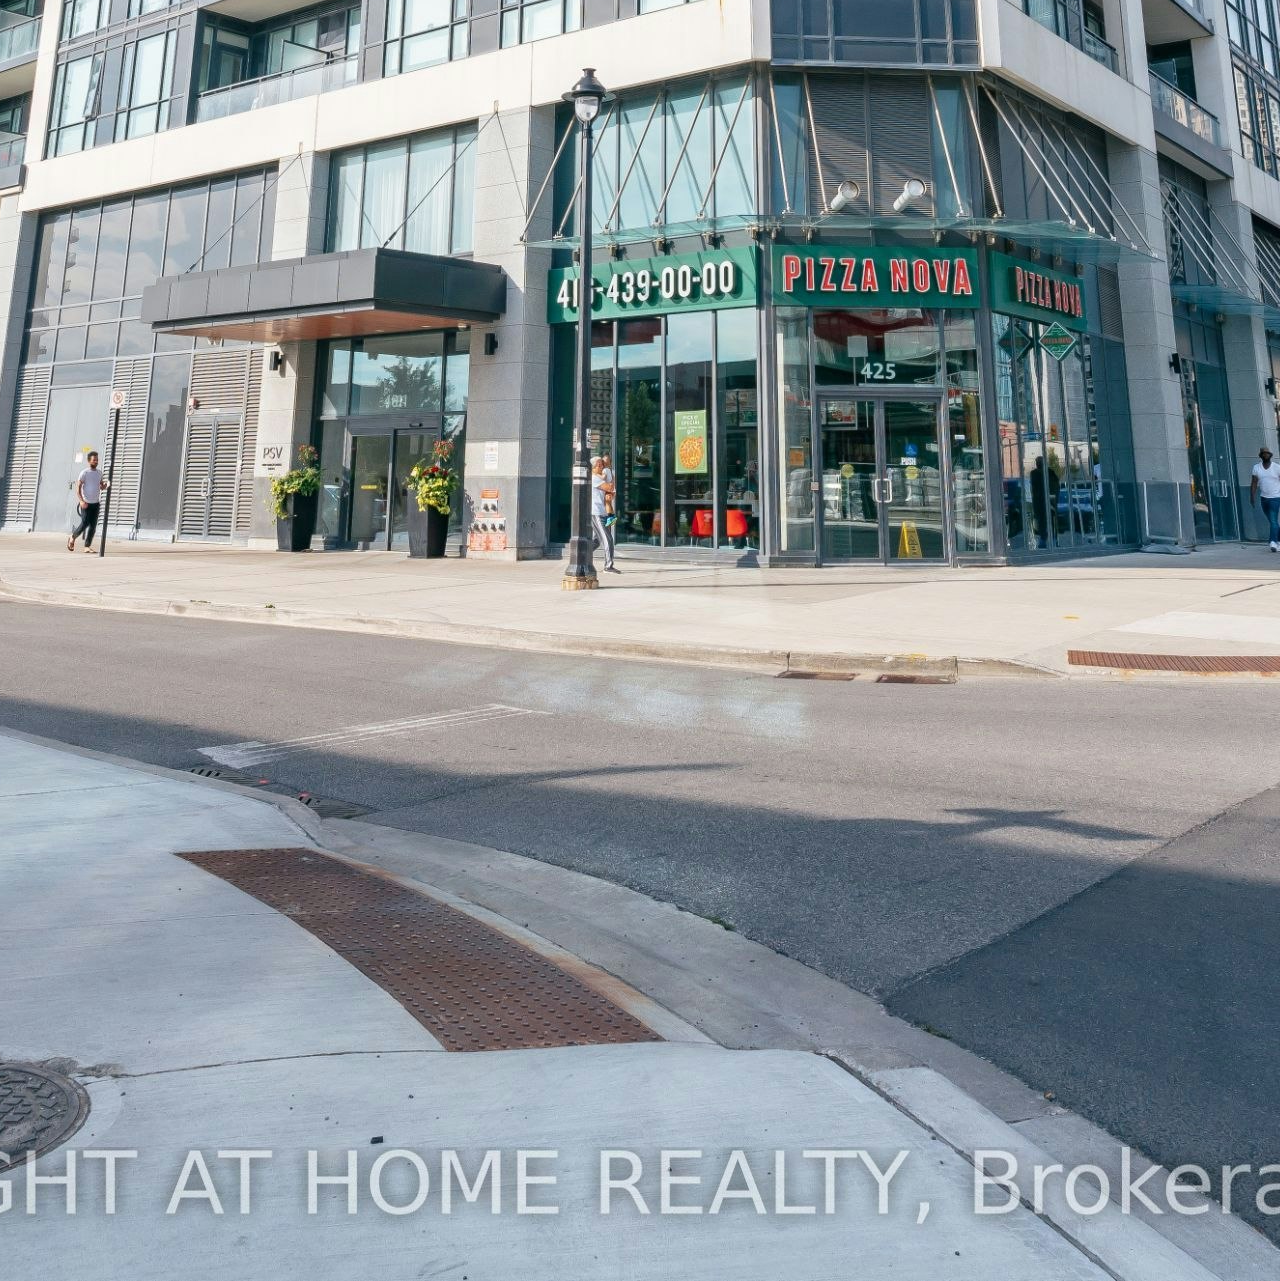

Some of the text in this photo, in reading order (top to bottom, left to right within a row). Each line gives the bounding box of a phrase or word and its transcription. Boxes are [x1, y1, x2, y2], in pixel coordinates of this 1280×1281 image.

[557, 261, 734, 308] 41-439-00-00
[783, 255, 972, 295] PIZZA NOVA
[1015, 266, 1082, 317] PIZZA NOVA
[861, 362, 896, 379] 425
[263, 446, 283, 459] PSV
